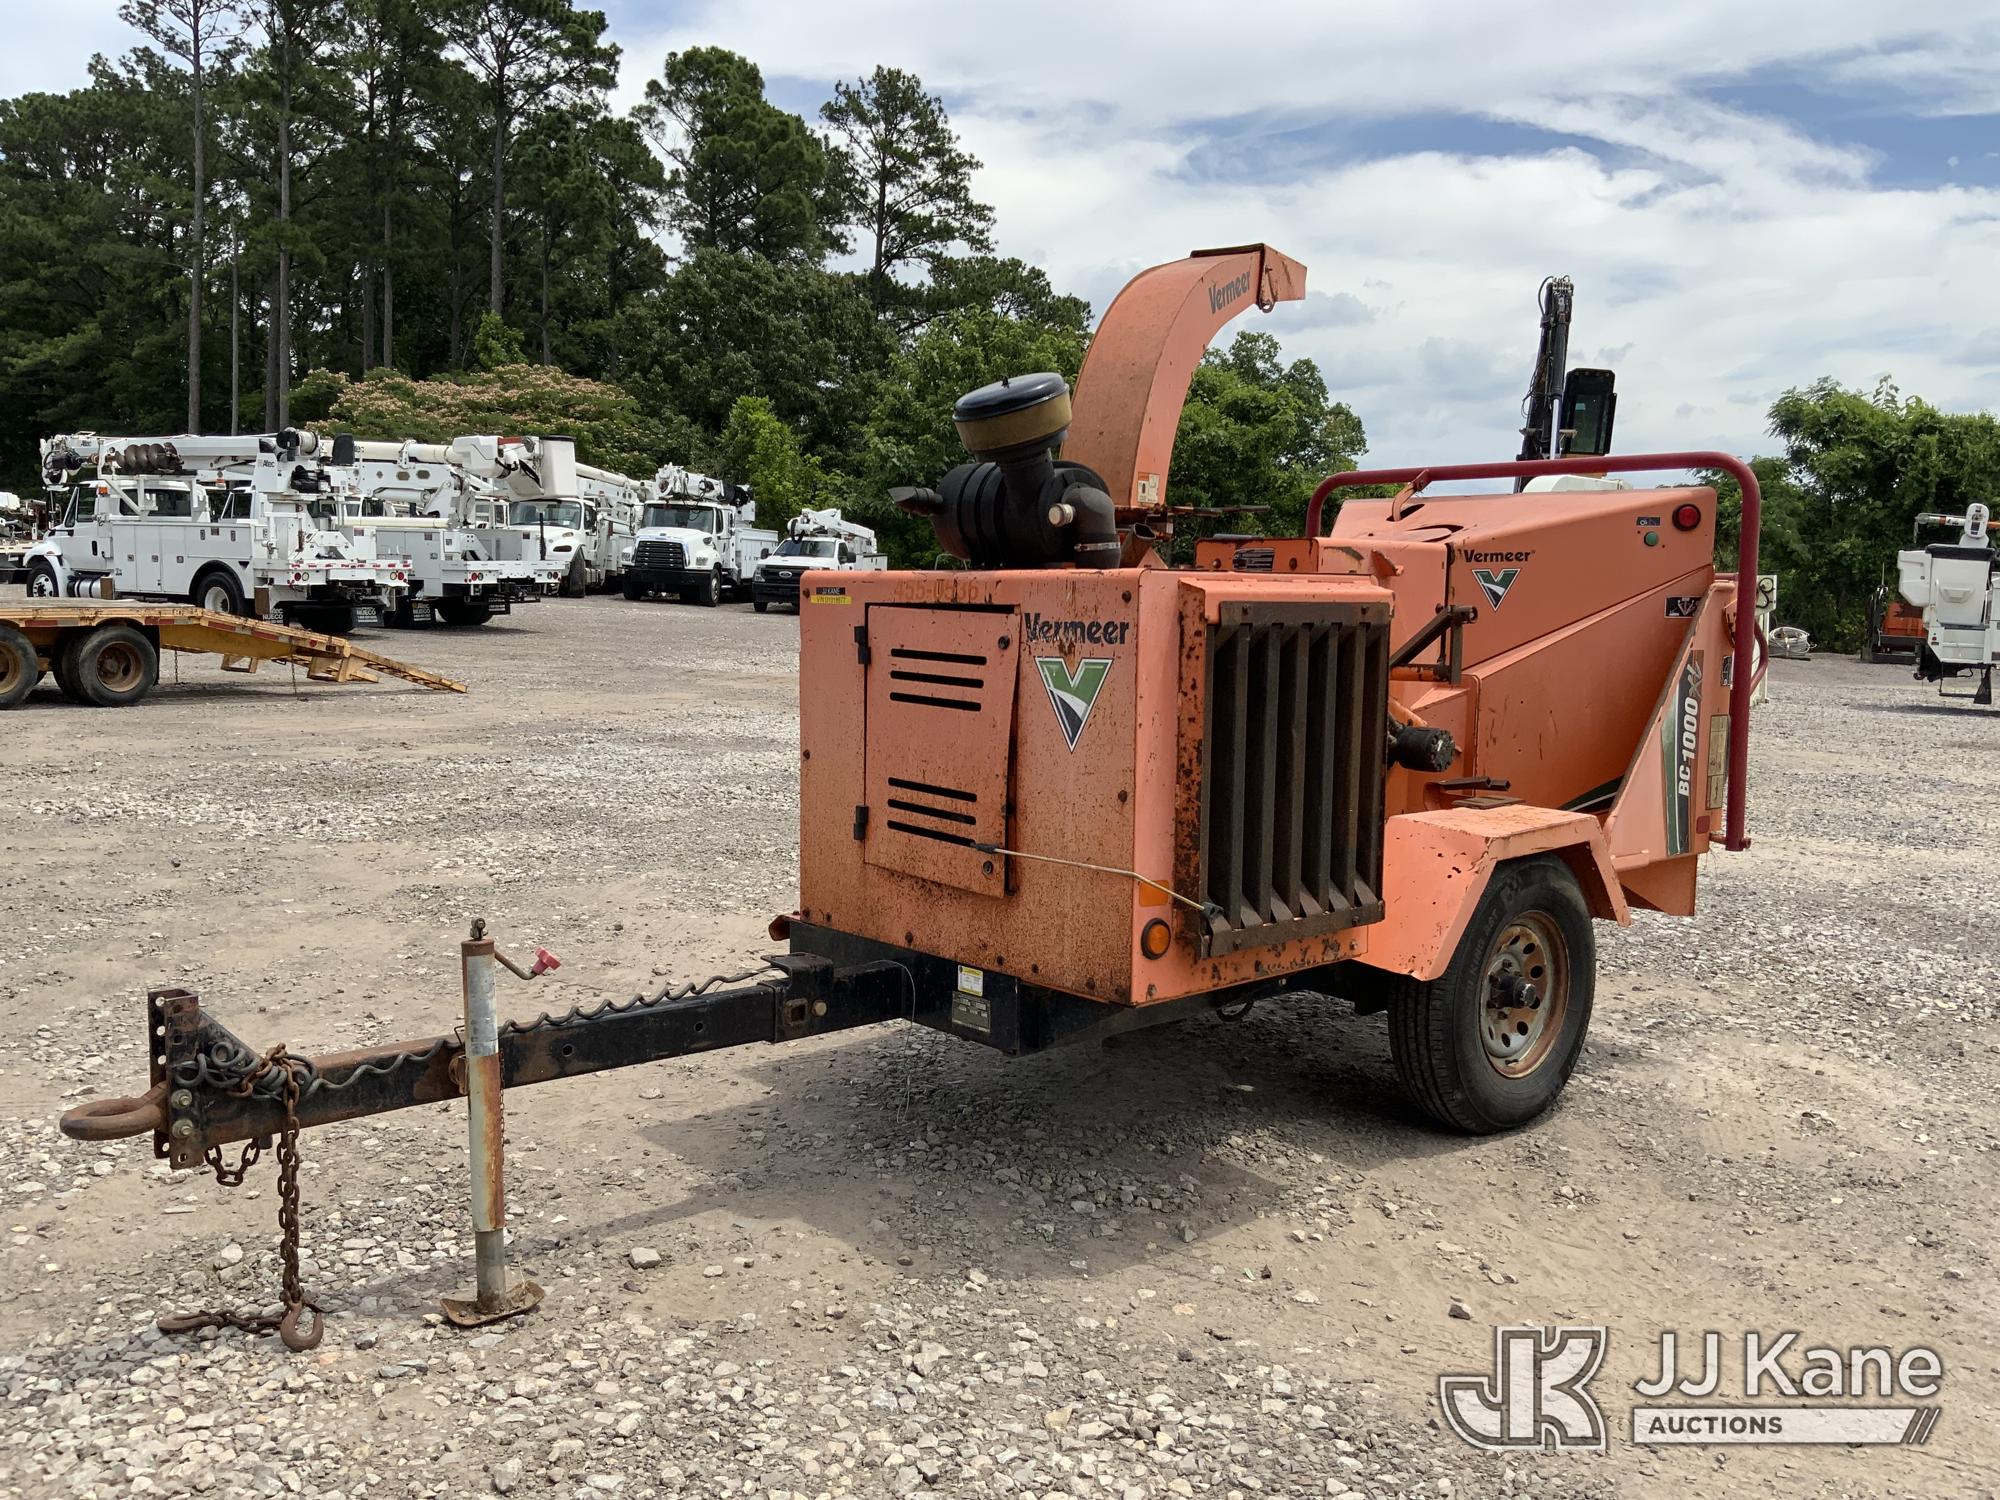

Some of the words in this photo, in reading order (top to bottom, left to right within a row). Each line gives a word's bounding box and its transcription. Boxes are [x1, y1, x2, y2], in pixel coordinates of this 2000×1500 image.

[1208, 271, 1250, 314] Vermeer
[1464, 549, 1531, 562] Vermeer
[1024, 612, 1130, 645] Vermeer
